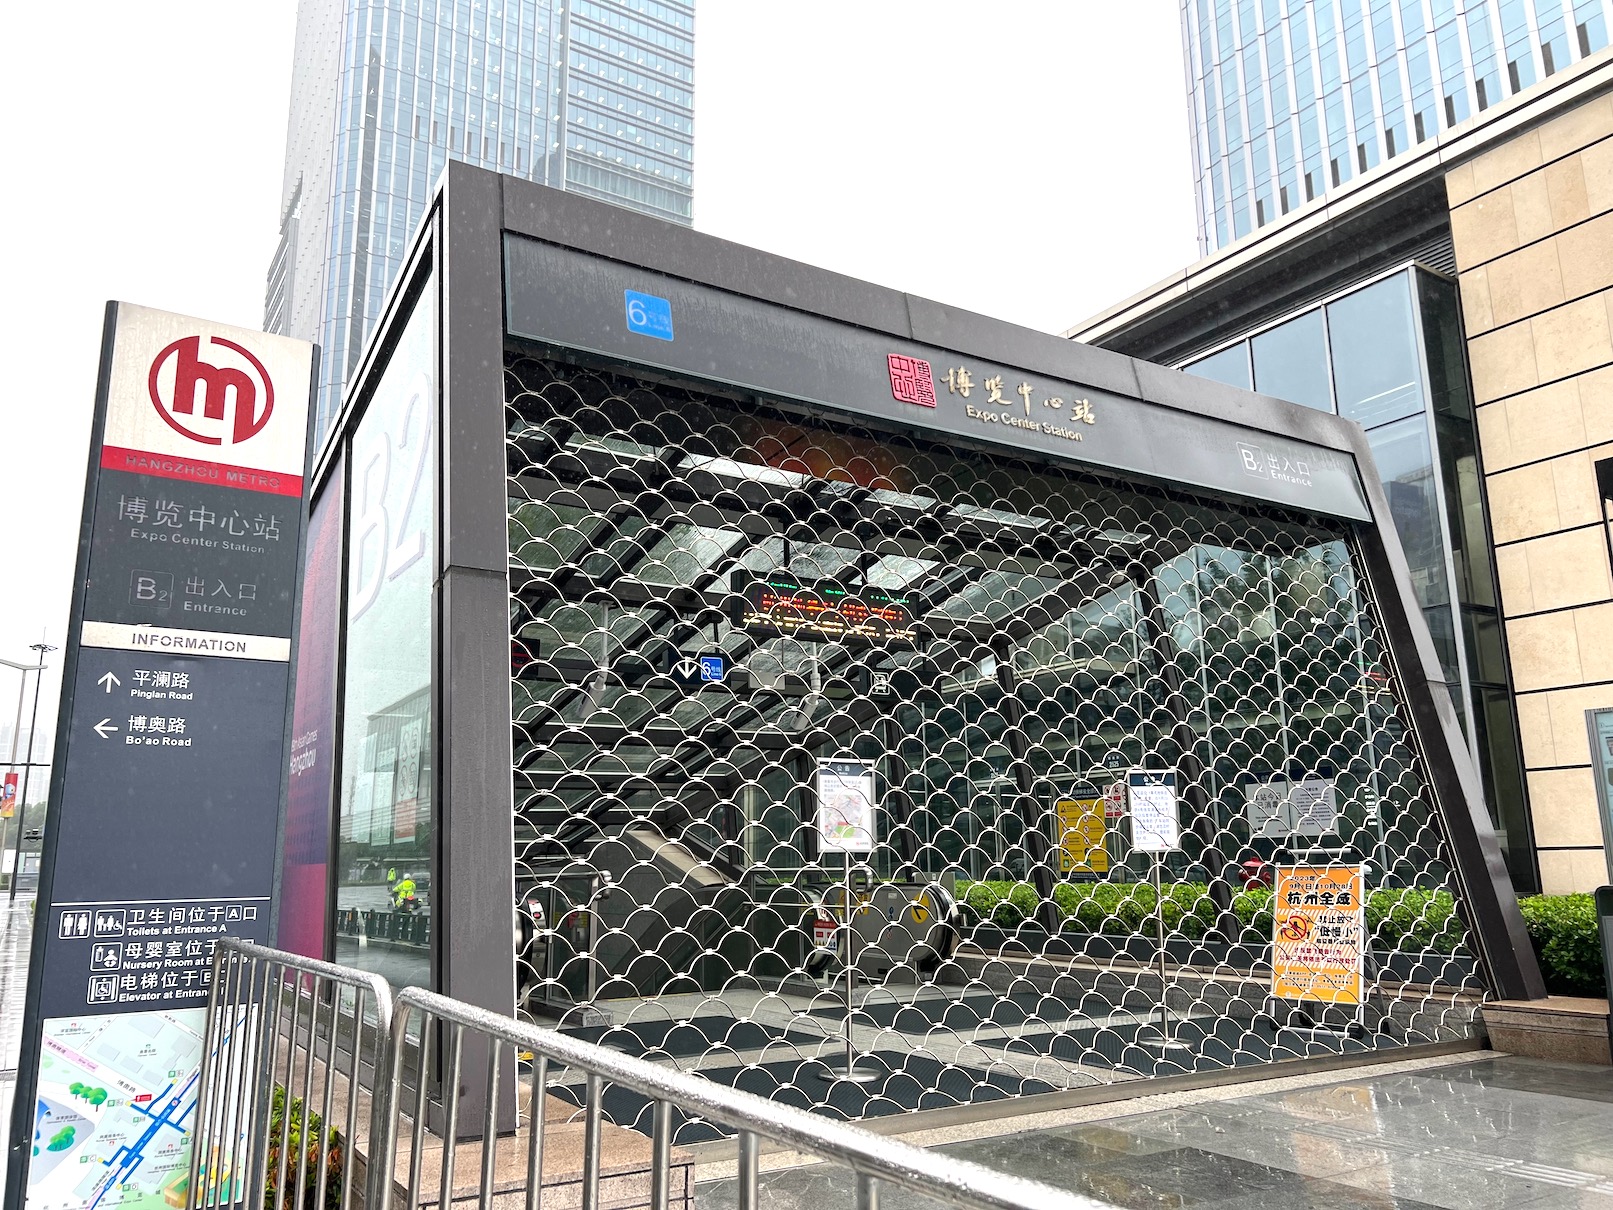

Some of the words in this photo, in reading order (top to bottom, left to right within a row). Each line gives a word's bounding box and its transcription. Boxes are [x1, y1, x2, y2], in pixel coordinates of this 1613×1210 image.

[629, 300, 647, 326] 6
[940, 366, 1095, 425] 博览中心站
[966, 404, 998, 423] Expo
[1000, 412, 1041, 431] Center
[1042, 421, 1083, 442] Station
[126, 454, 219, 479] HANGZHOU
[226, 470, 281, 488] METRO
[1267, 453, 1311, 476] 出入口
[1271, 470, 1313, 487] Entrance
[117, 494, 281, 541] 博览中心站
[131, 527, 168, 543] Expo
[171, 533, 219, 549] Center
[222, 540, 265, 554] Station
[185, 576, 257, 601] 出入口
[183, 601, 248, 617] Entrance
[132, 633, 247, 653] INFORMATION
[132, 669, 190, 689] 平澜路
[130, 689, 167, 700] Pinglan
[168, 690, 193, 701] Road
[127, 715, 186, 734] 博奥路
[125, 735, 160, 746] Bo'ao
[162, 736, 192, 747] Road
[127, 926, 160, 937] Toilets
[162, 926, 172, 935] at
[174, 924, 218, 935] Entrance
[219, 924, 227, 933] A
[122, 960, 163, 971] Nursery
[164, 958, 193, 968] Room
[195, 957, 205, 966] at
[118, 991, 162, 1002] Elevator
[163, 991, 173, 1000] at
